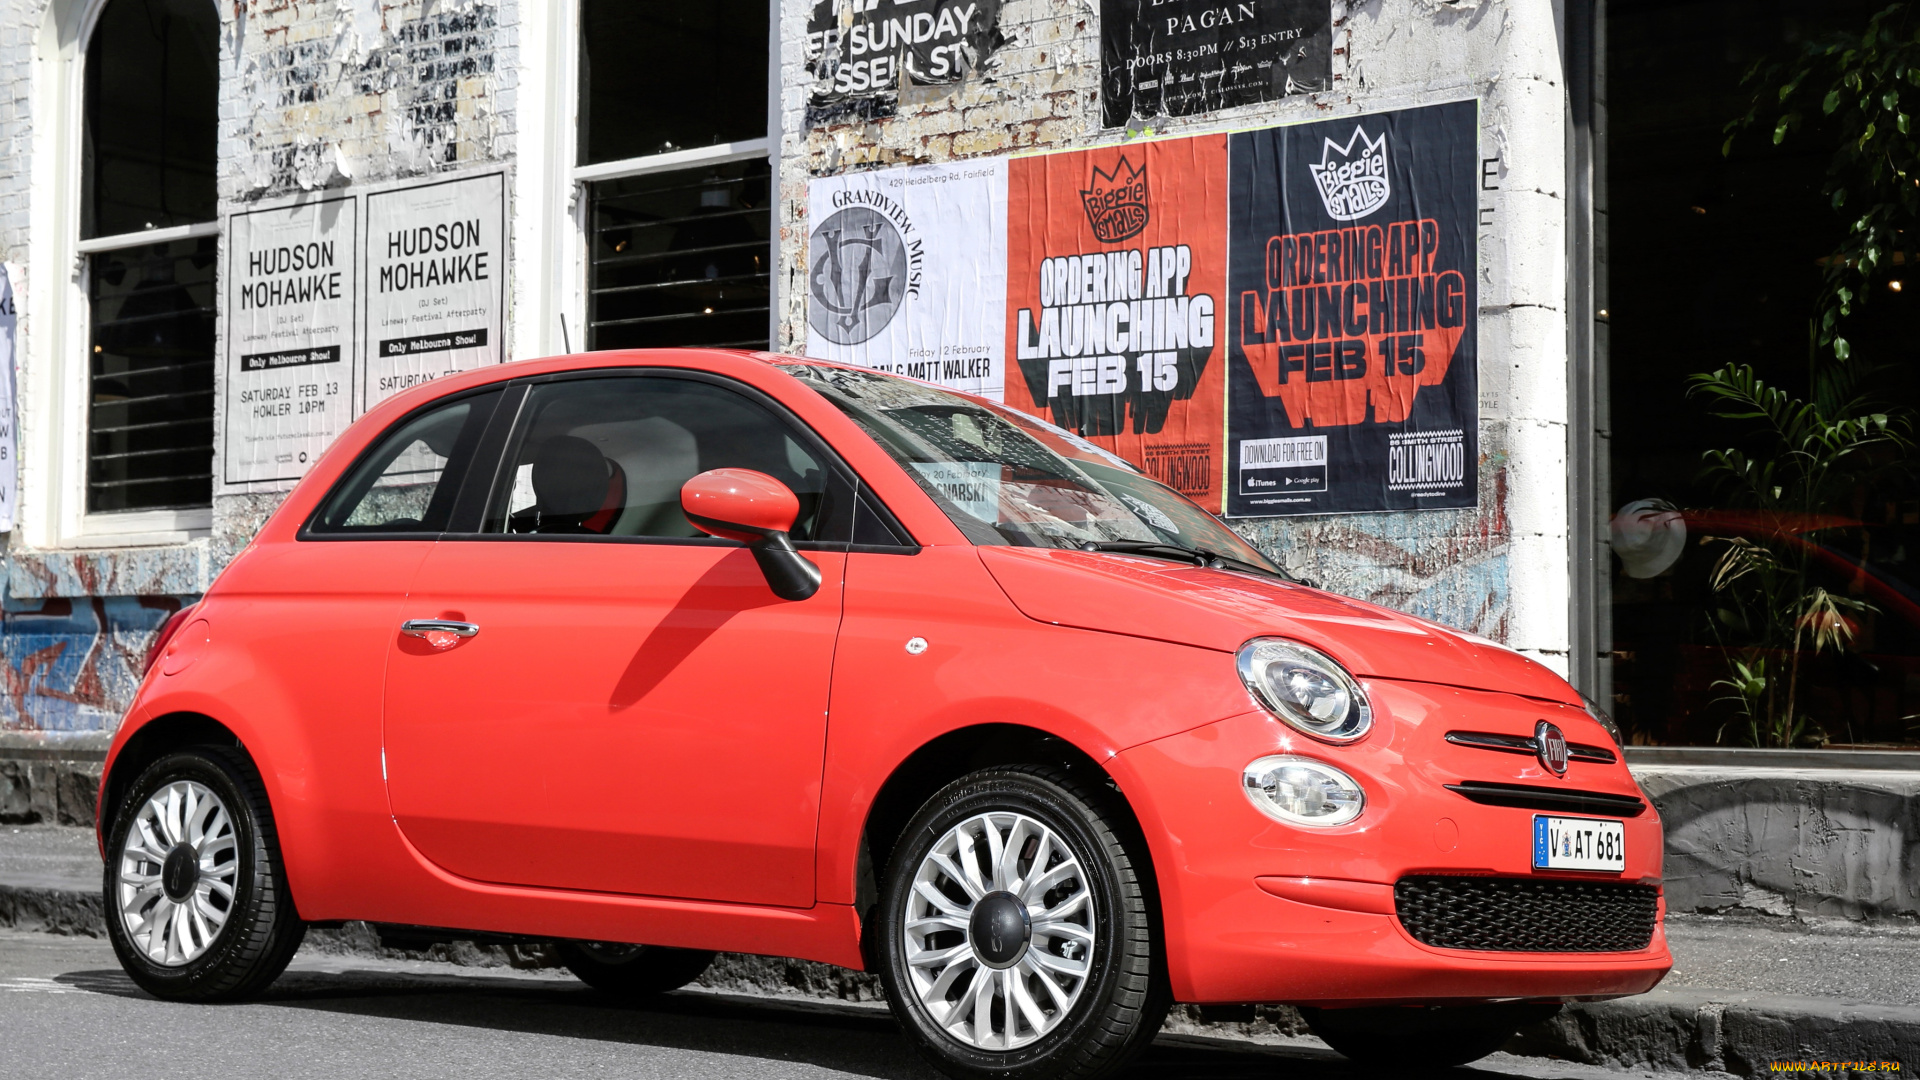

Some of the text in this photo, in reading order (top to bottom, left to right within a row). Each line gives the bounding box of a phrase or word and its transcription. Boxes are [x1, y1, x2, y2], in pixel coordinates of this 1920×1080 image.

[851, 2, 977, 55] SUNDAY
[1167, 2, 1257, 36] PAGAN
[1126, 51, 1173, 70] DOORS
[1176, 43, 1218, 61] 8:30PM
[1239, 36, 1257, 50] $13
[1260, 28, 1303, 44] ENTRY
[889, 168, 995, 188] 429 Heidelberg Rd, Fairfield
[833, 189, 916, 236] GRANDVIEW
[388, 218, 480, 259] HUDSON
[1266, 219, 1438, 290] ORDERING APP
[250, 240, 334, 277] HUDSON
[380, 251, 489, 293] MOHAWKE
[1040, 245, 1191, 307] ORDERING APP
[242, 272, 341, 310] MOHAWKE
[1241, 270, 1465, 345] LAUNCHING
[411, 312, 442, 322] Festival
[446, 307, 487, 319] Afterparty
[1017, 294, 1214, 359] LAUNCHING
[249, 350, 331, 368] Only Melbourne Show!
[389, 342, 406, 354] Only
[455, 334, 477, 346] Show!
[909, 348, 935, 359] Friday
[952, 344, 991, 356] February
[1278, 334, 1426, 384] FEB 15
[908, 361, 939, 381] MATT
[944, 358, 990, 380] WALKER
[1048, 351, 1179, 397] FEB 15
[241, 382, 338, 403] SATURDAY FEB 13
[253, 400, 325, 418] HOWLER 10PM
[1245, 441, 1323, 464] DOWNLOAD FOR FREE ON
[1389, 443, 1464, 484] COLLINGWOOD
[1256, 479, 1277, 487] iTunes
[1294, 477, 1310, 485] Google
[1548, 738, 1564, 761] FIAT
[1597, 832, 1622, 861] 681
